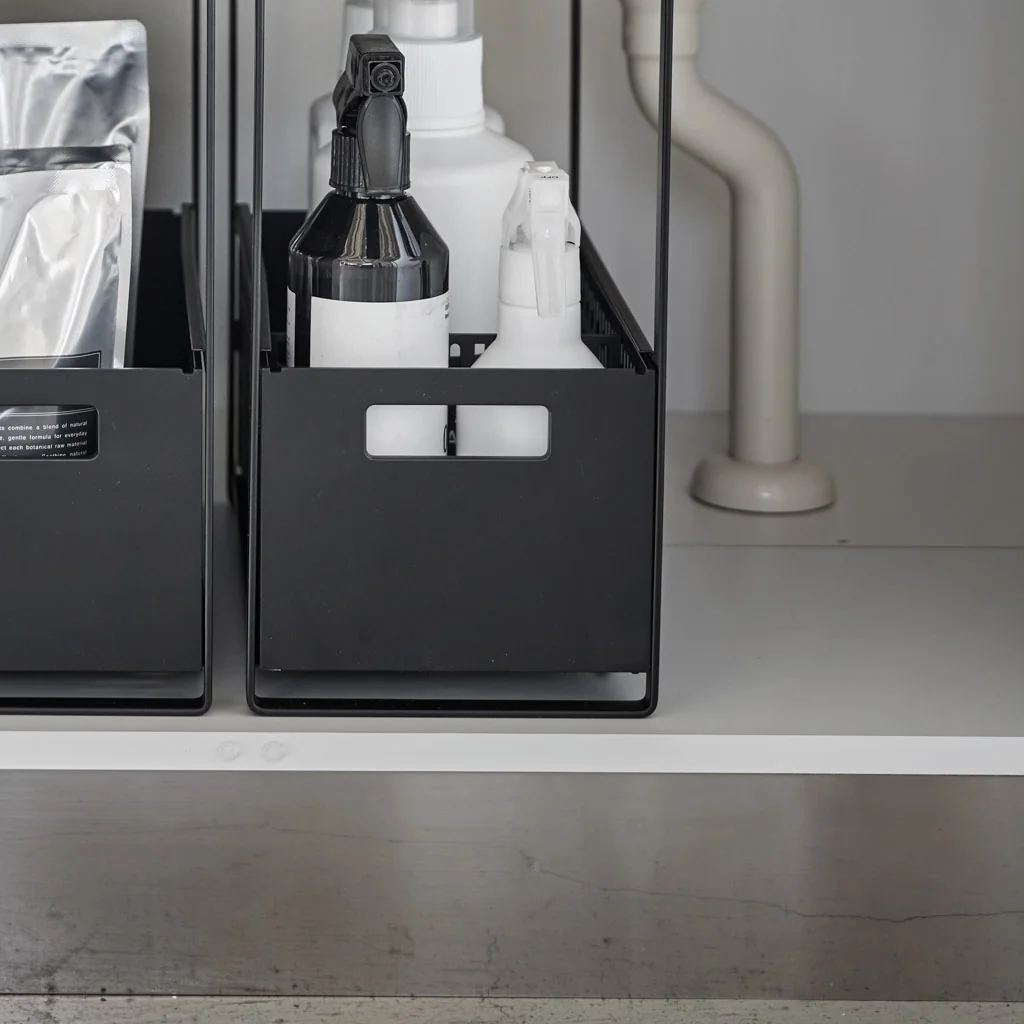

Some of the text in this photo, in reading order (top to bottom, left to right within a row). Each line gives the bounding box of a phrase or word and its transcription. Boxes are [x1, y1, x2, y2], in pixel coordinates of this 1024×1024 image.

[69, 420, 88, 428] natural
[7, 434, 27, 442] gentle
[64, 431, 88, 439] everyday
[25, 443, 53, 451] botanical
[66, 440, 88, 448] material
